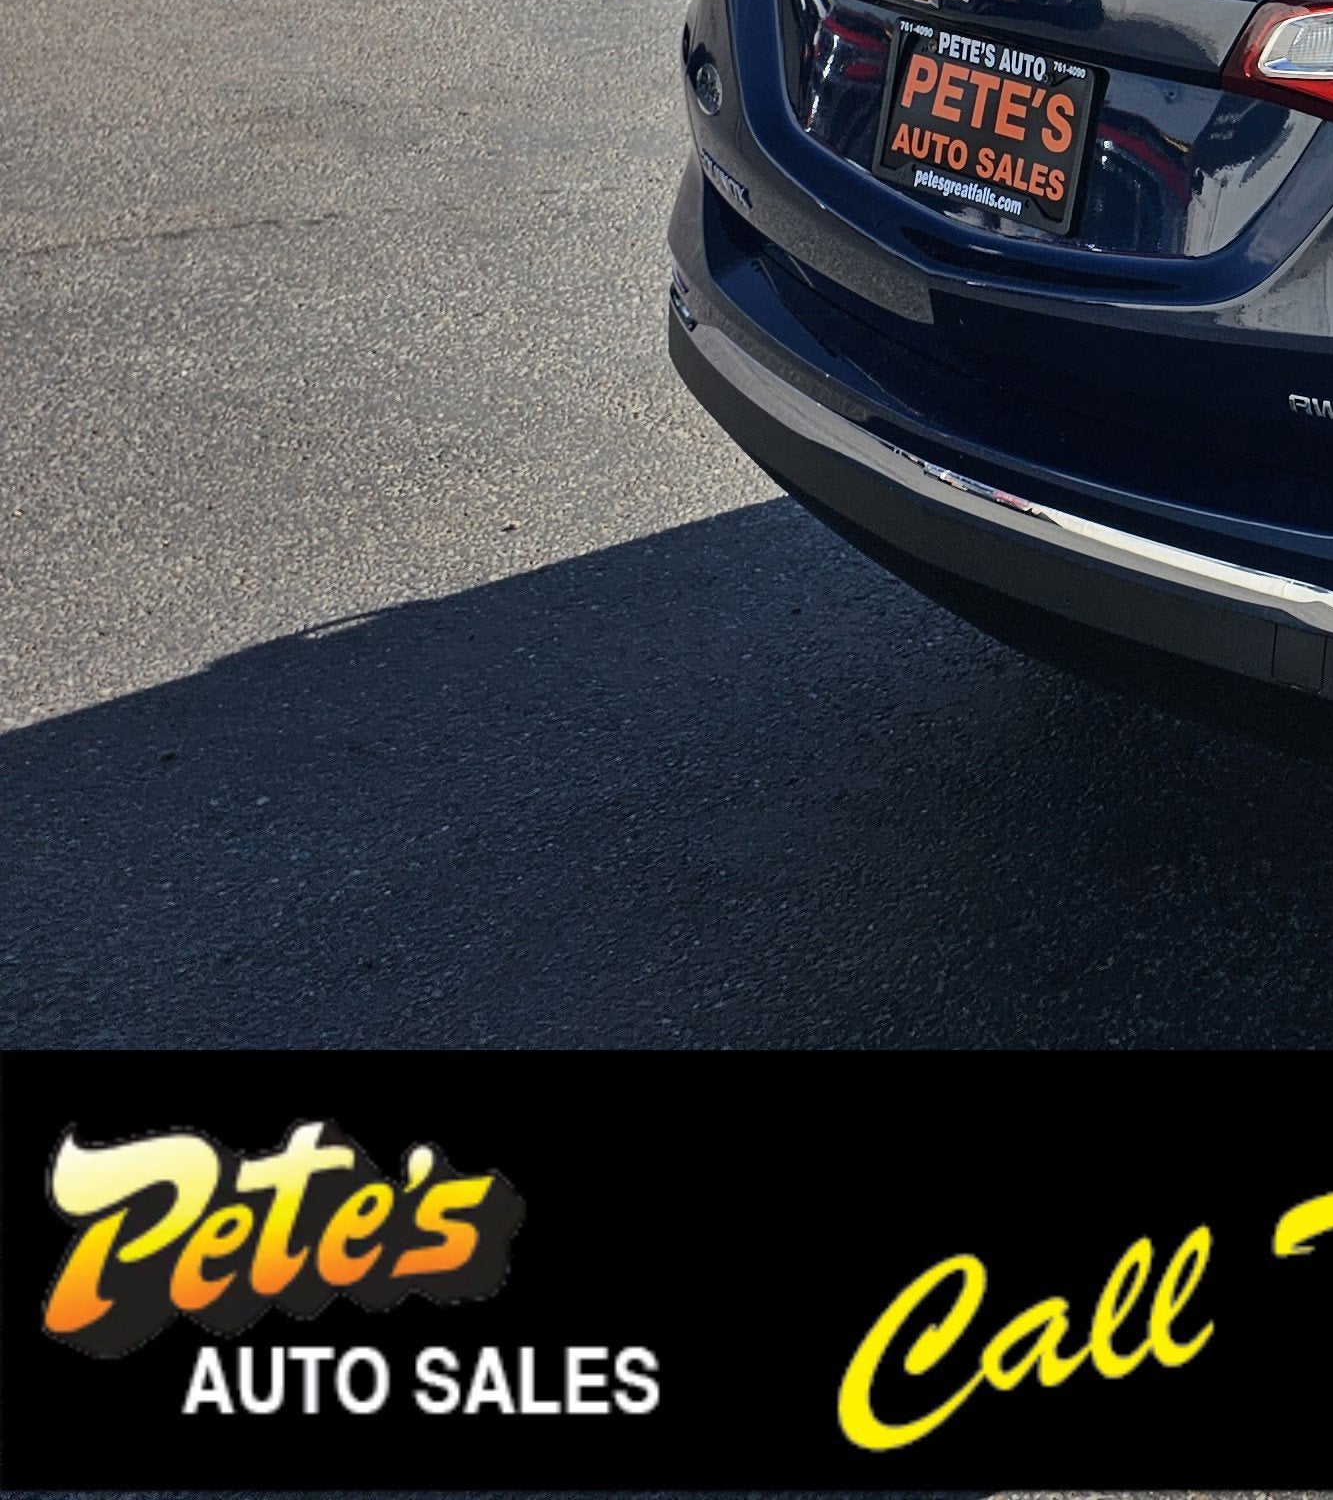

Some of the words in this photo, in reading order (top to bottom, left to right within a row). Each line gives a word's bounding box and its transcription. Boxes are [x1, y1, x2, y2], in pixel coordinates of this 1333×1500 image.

[899, 20, 934, 38] 761-4090
[938, 31, 997, 68] PETE'S
[998, 48, 1047, 82] AUTO
[1052, 60, 1087, 79] 761-4090
[900, 53, 1076, 154] PETE'S
[890, 122, 969, 171] AUTO
[975, 146, 1066, 202] SALES
[913, 168, 1023, 216] petesgreatfalls.com
